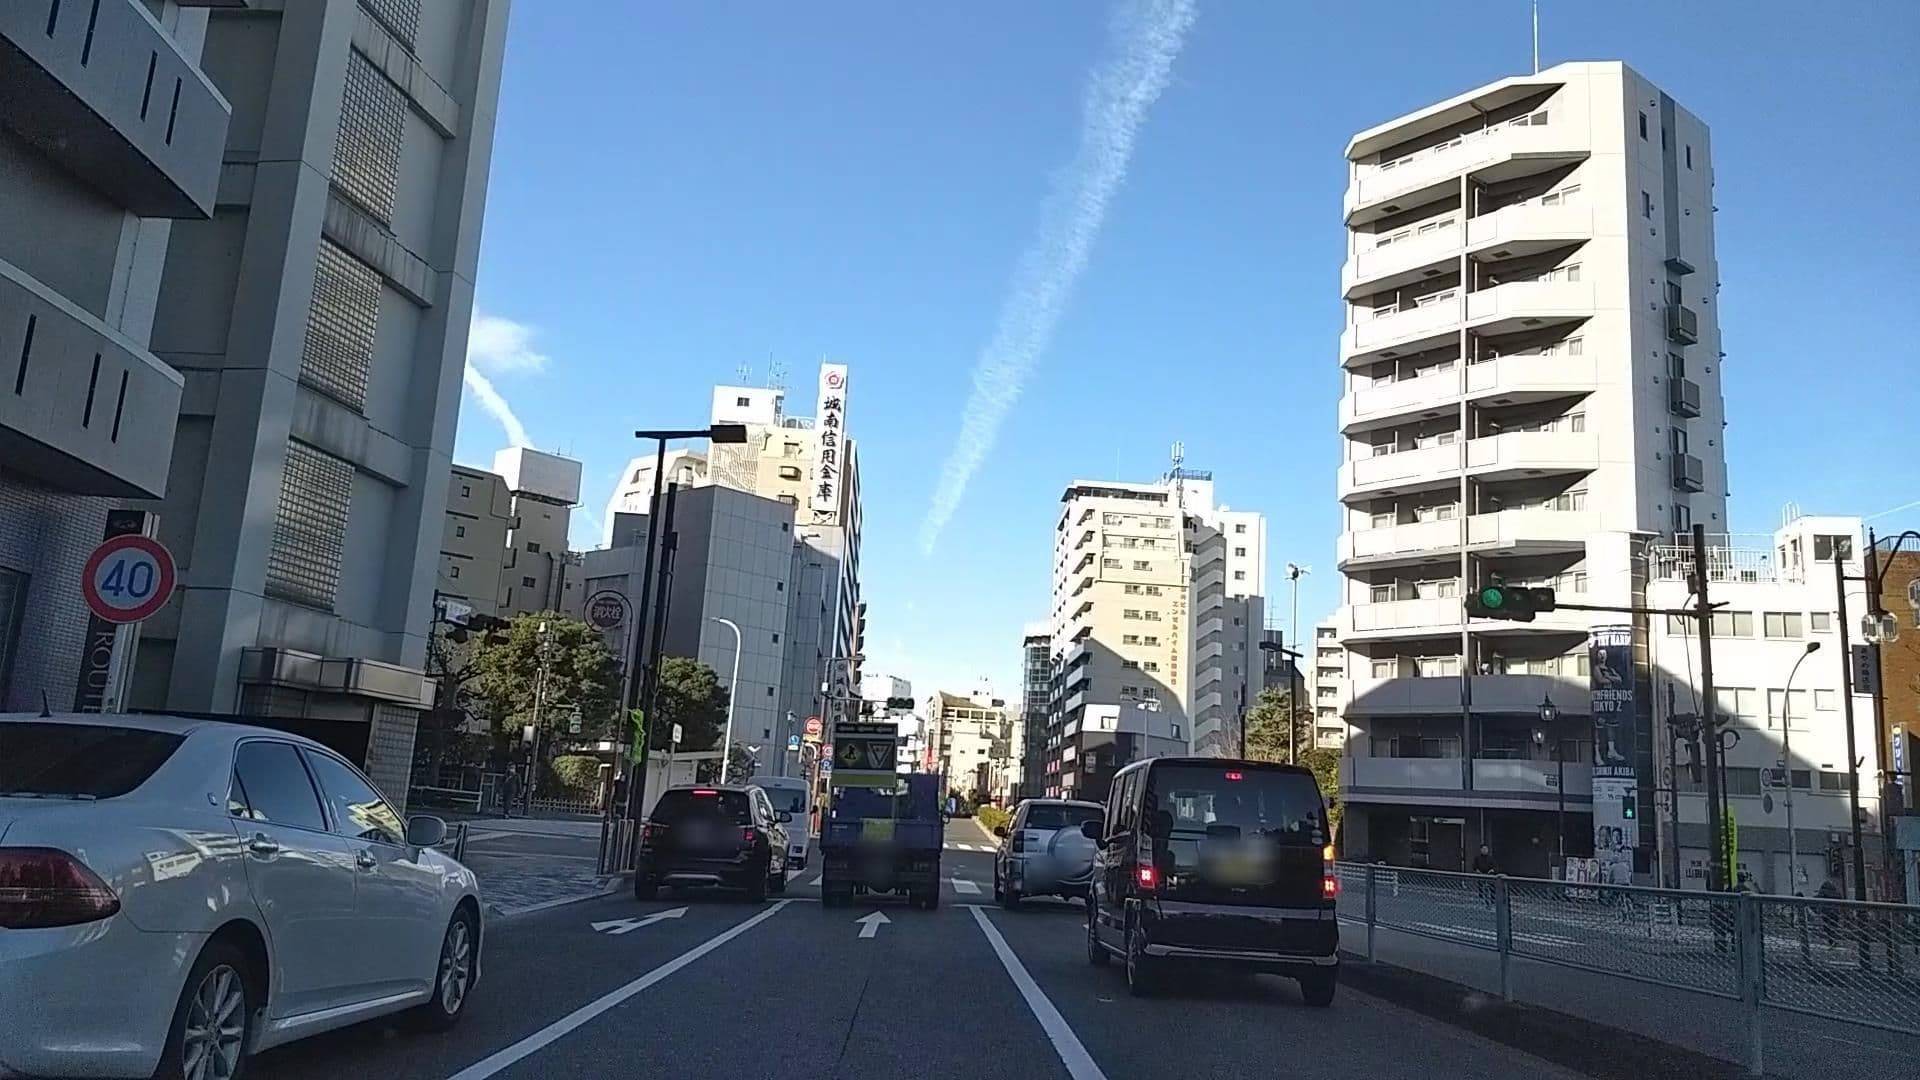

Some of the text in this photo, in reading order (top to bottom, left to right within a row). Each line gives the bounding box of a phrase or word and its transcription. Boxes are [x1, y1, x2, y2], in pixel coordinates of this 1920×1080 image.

[815, 396, 842, 502] 城南信用金庫
[101, 558, 154, 599] 40
[592, 604, 622, 620] 消火栓
[1593, 700, 1614, 712] TOKYO
[1613, 766, 1635, 777] AKIBA
